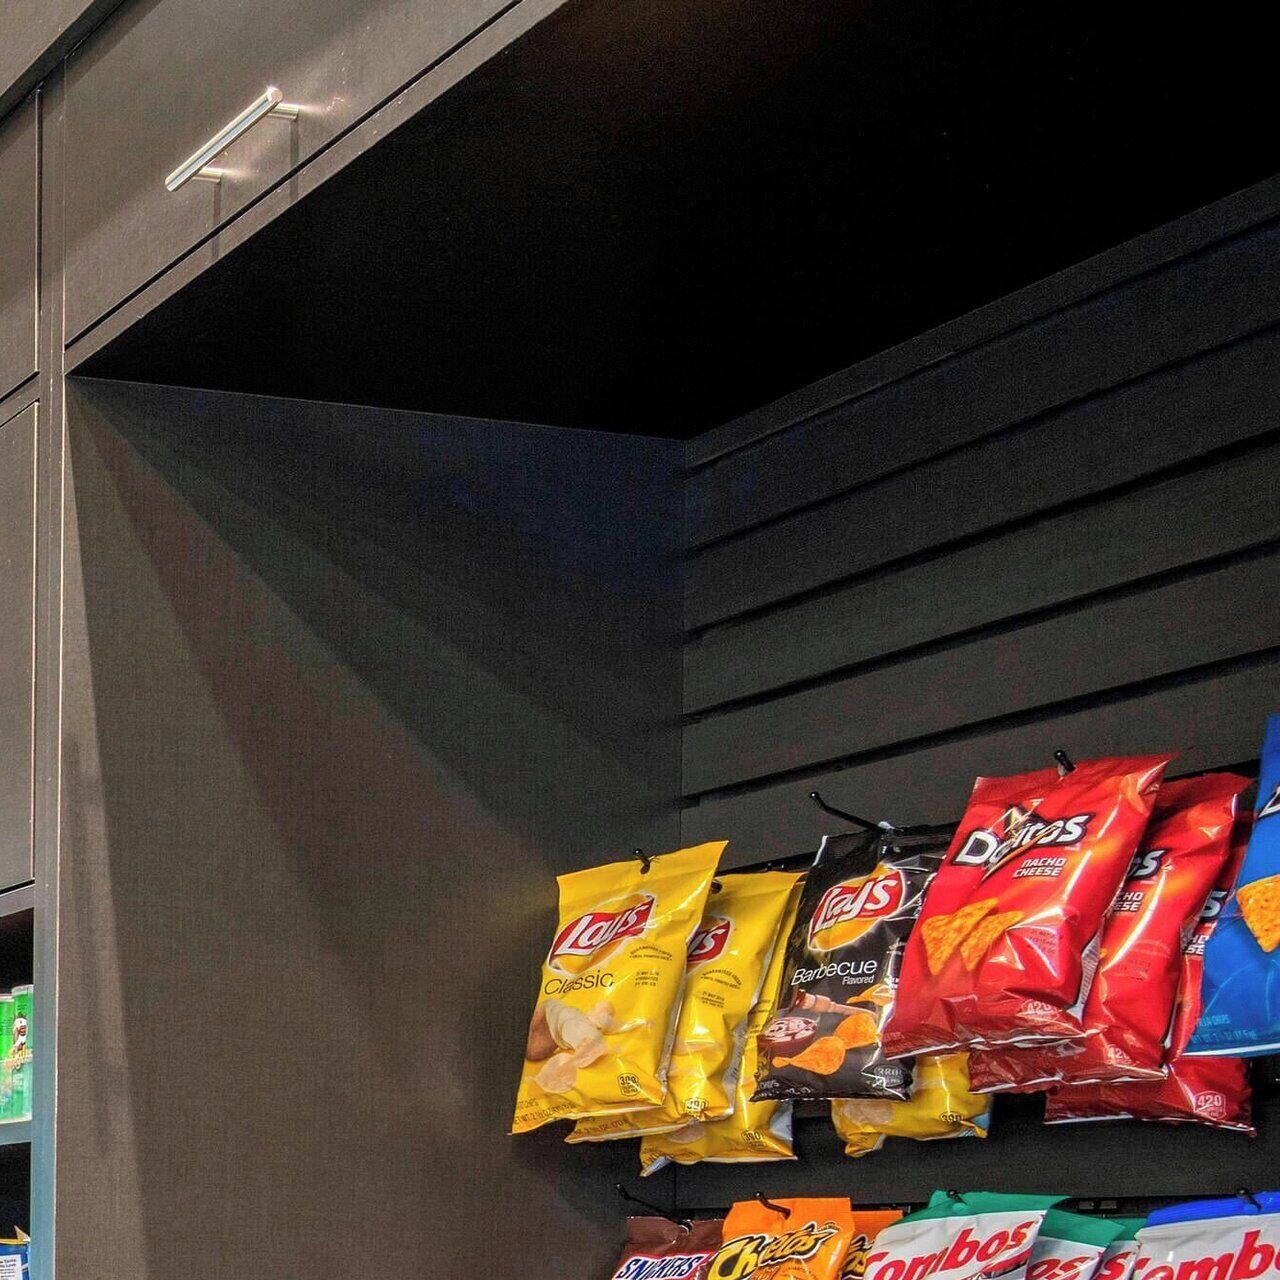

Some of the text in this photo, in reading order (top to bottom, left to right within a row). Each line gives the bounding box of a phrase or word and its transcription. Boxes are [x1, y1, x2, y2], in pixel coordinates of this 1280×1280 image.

[954, 812, 1093, 868] Doritos
[1012, 866, 1063, 879] CHEESE
[1020, 856, 1067, 869] NACHO
[814, 873, 897, 933] Lay's
[553, 901, 644, 956] Lay's
[544, 968, 615, 996] Classic
[790, 958, 878, 986] Barbecue
[842, 974, 875, 986] Flavored
[1196, 1093, 1224, 1109] 420
